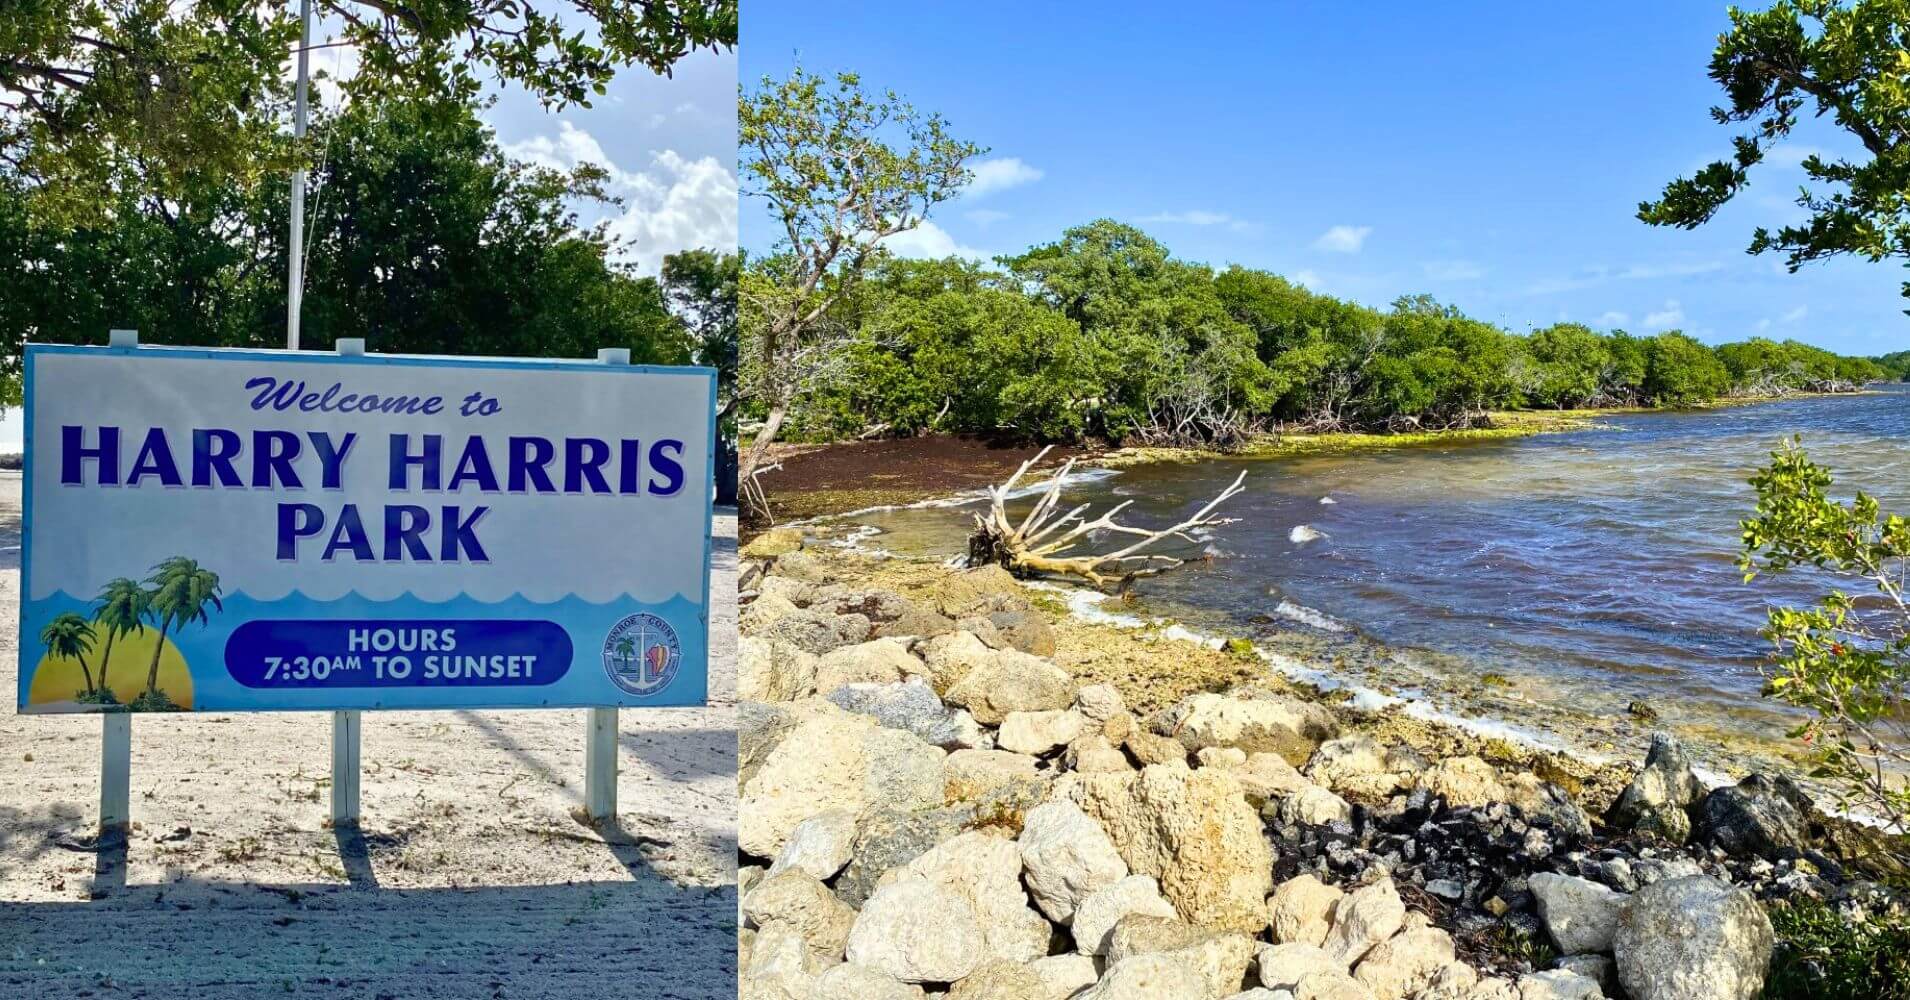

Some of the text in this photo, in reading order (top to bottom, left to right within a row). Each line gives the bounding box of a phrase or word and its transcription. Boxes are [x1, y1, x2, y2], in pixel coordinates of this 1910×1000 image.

[245, 376, 502, 417] Welcome to
[61, 425, 686, 496] HARRY HARRIS
[276, 503, 491, 562] PARK
[348, 628, 457, 652] HOURS
[605, 617, 678, 651] MONROE COUNTY
[263, 655, 537, 680] 7:30AM TO SUNSET
